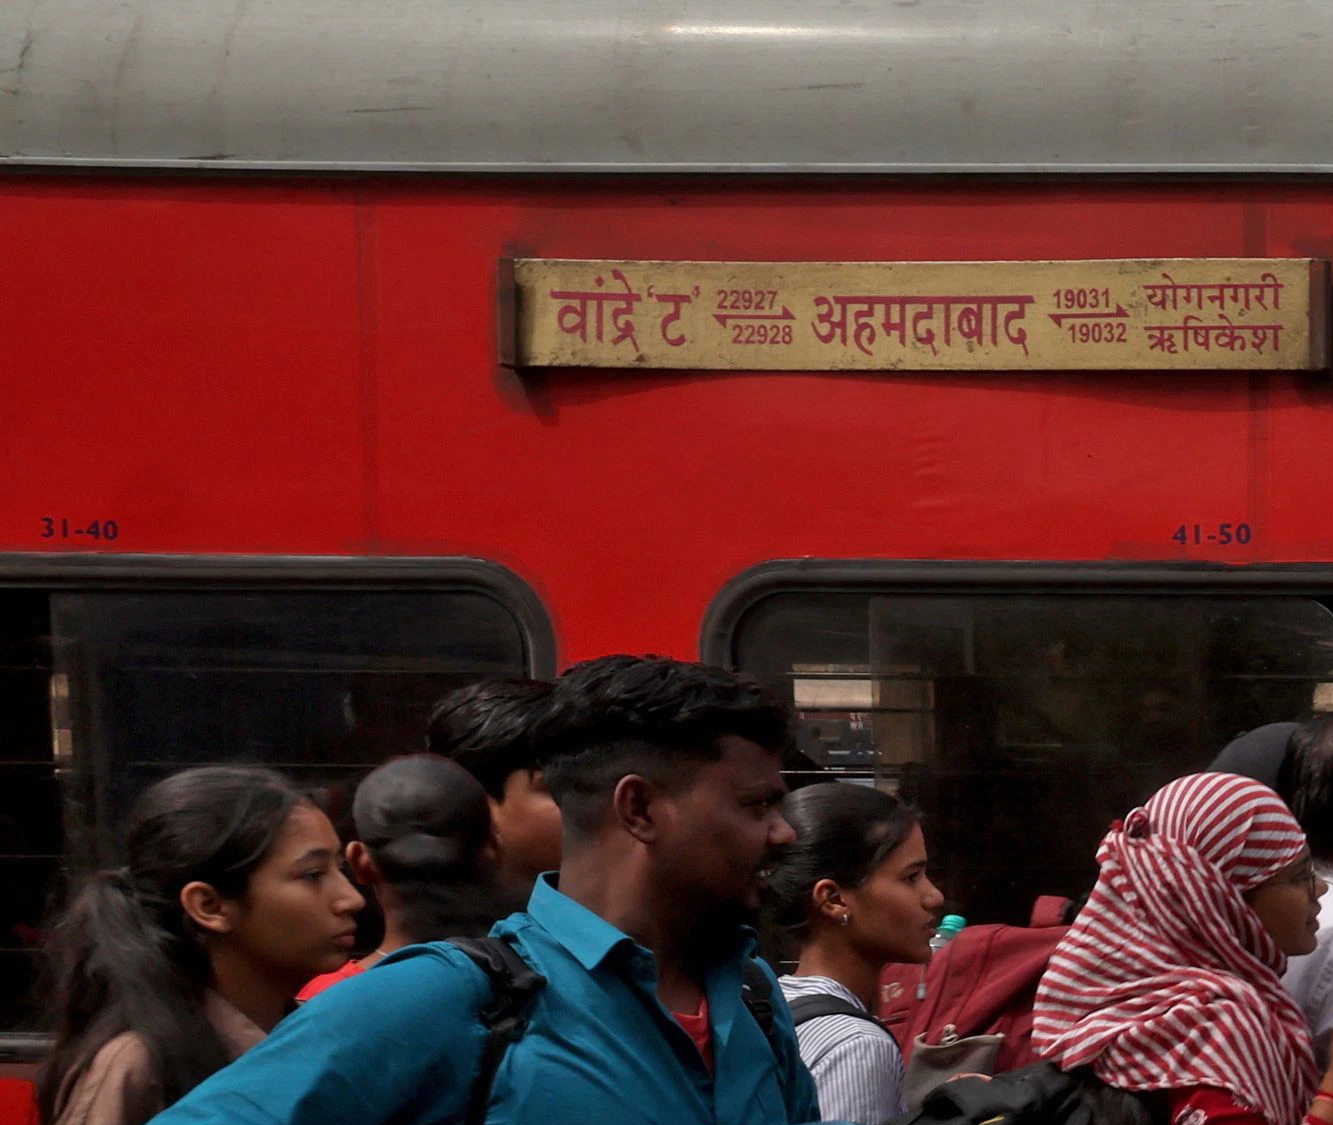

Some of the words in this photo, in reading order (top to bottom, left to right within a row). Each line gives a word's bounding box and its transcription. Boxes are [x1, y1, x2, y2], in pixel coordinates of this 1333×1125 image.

[716, 290, 778, 310] 22927
[1053, 288, 1110, 309] 19031
[1143, 273, 1284, 311] योगनगरी
[731, 325, 793, 345] 22928
[811, 295, 1035, 356] अहमदाबाद
[1067, 322, 1127, 344] 19032
[1143, 314, 1284, 355] ऋषिकेश
[41, 517, 118, 540] 31-40
[1172, 523, 1251, 545] 41-50
